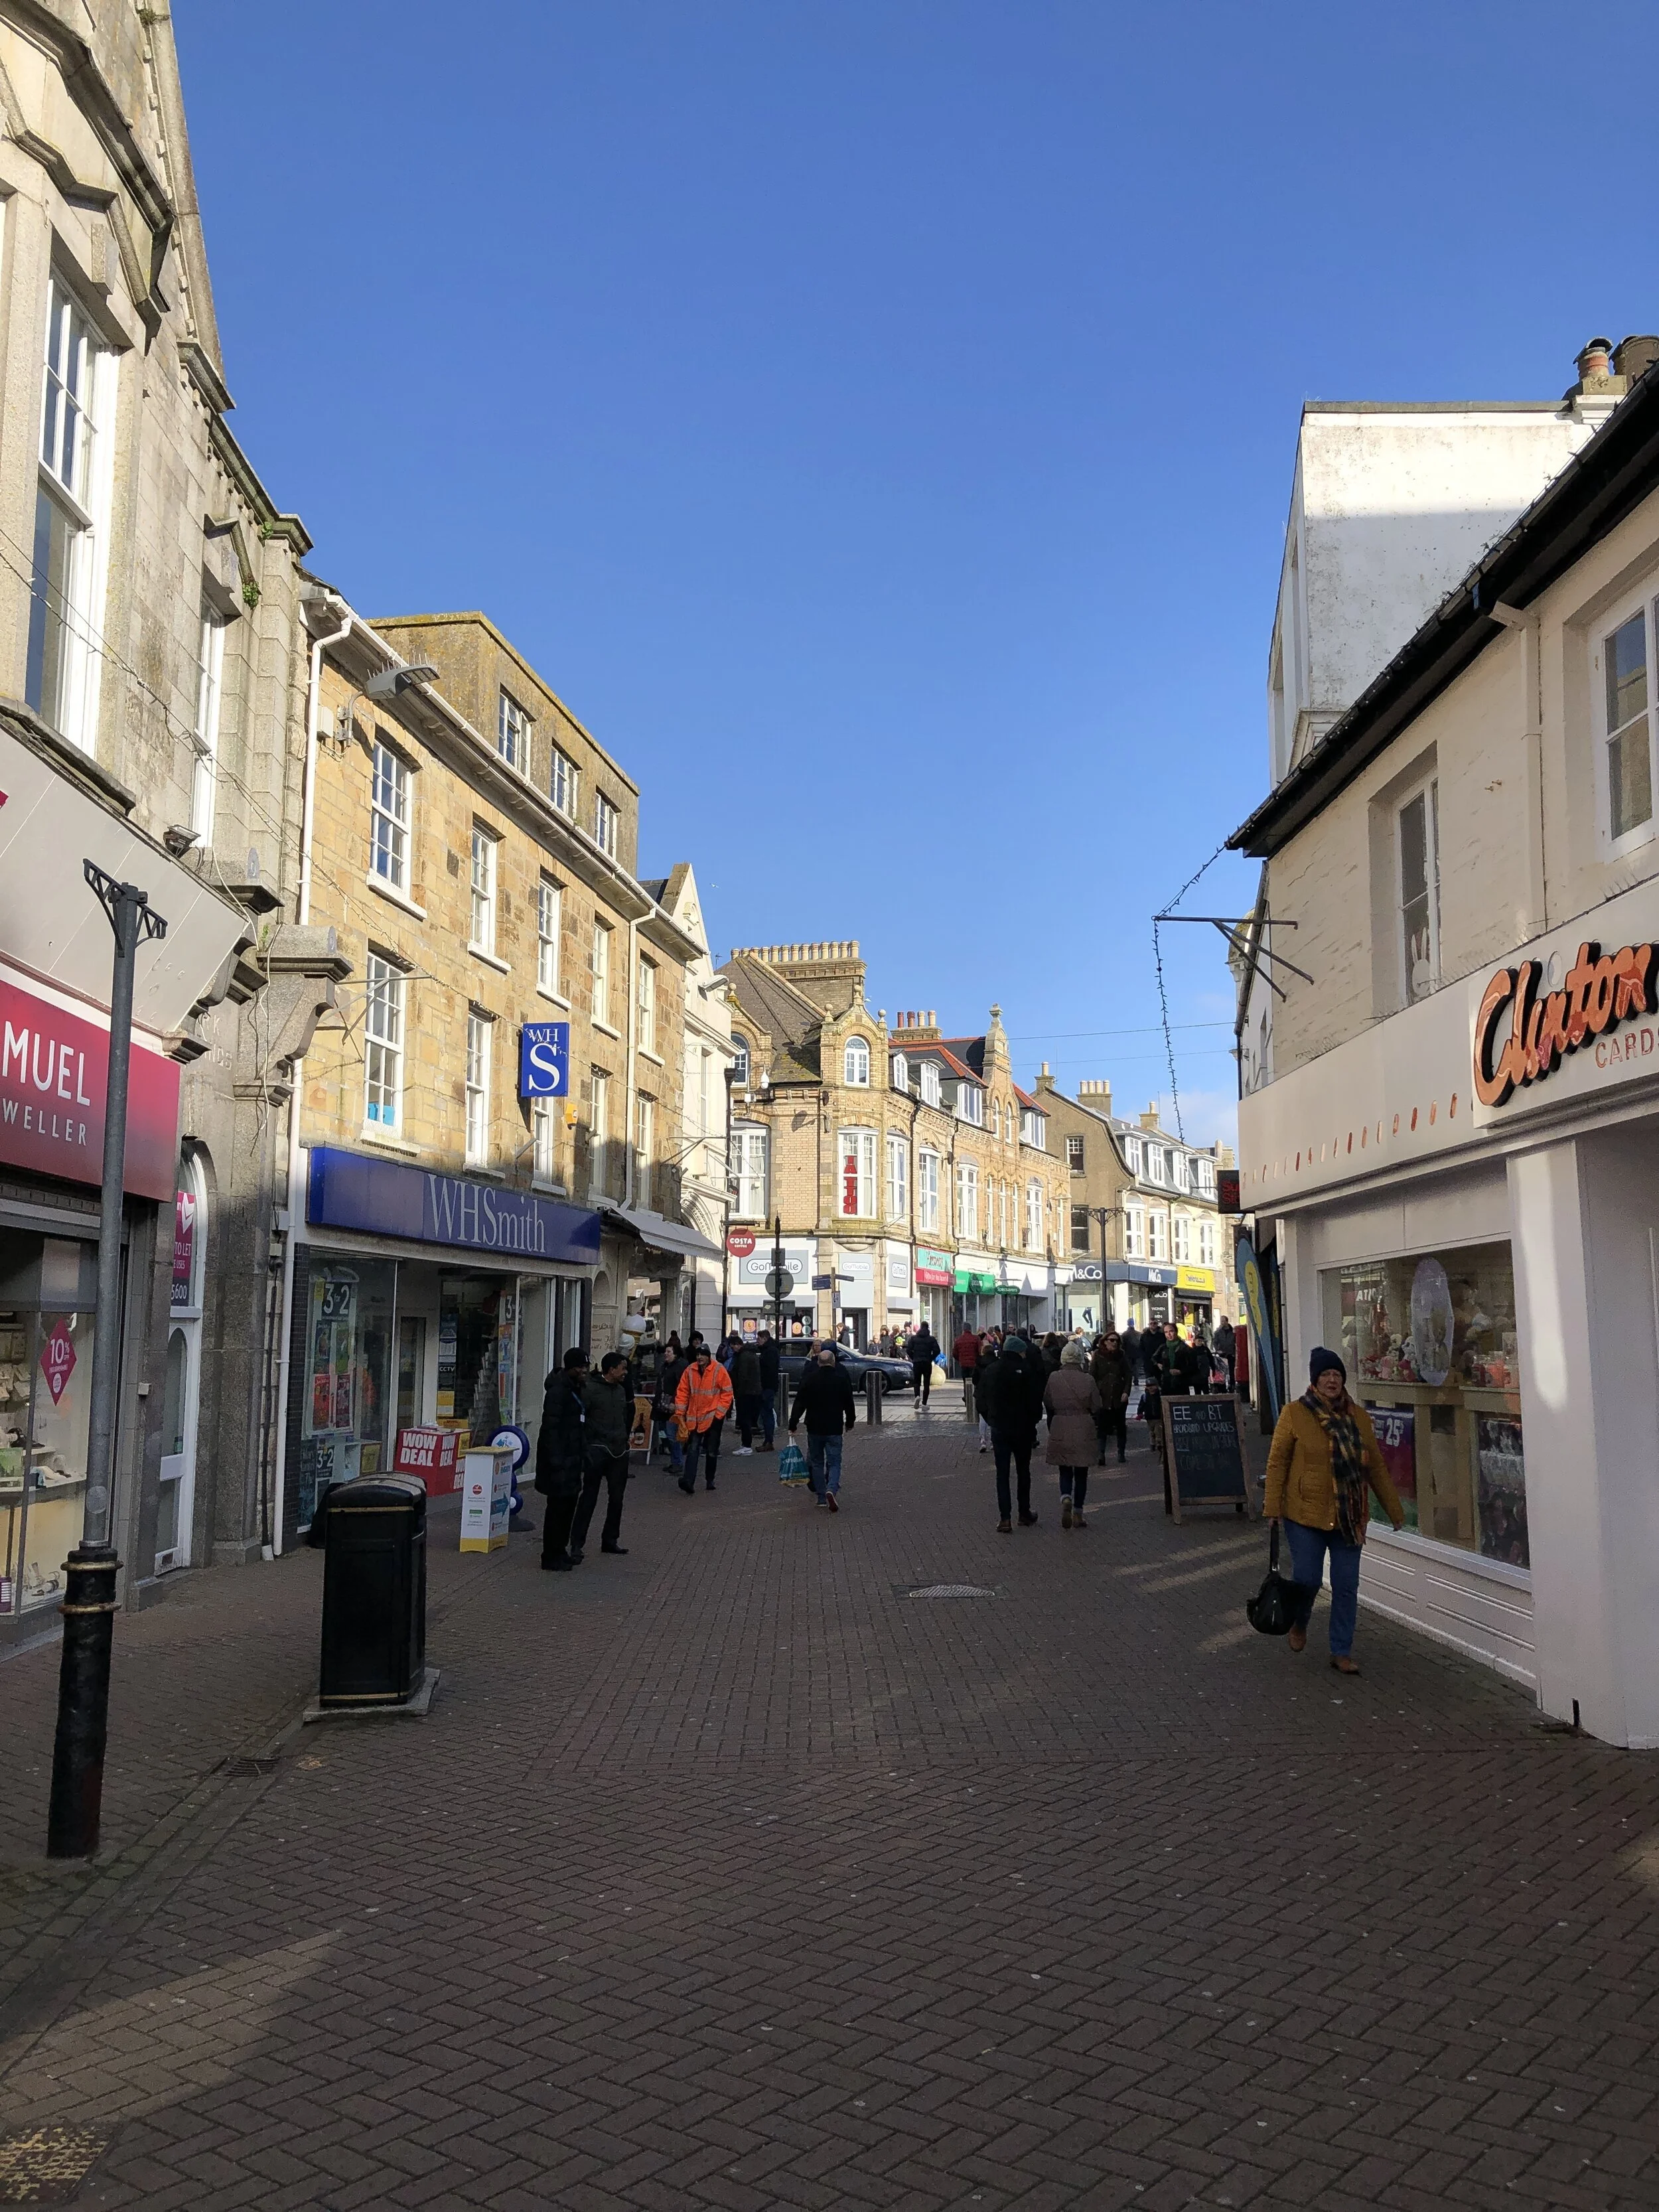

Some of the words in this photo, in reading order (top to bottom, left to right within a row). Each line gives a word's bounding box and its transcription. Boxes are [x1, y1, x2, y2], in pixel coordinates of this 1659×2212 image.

[528, 1028, 559, 1043] WH
[1594, 1028, 1659, 1069] CARD
[528, 1043, 559, 1091] S
[2, 1098, 86, 1146] WELLER
[427, 1173, 546, 1253] WHSmith
[175, 1241, 182, 1256] TO
[182, 1242, 192, 1257] LET
[751, 1261, 799, 1271] GoMile
[323, 1283, 334, 1314] 3
[339, 1284, 350, 1315] 2
[1173, 1406, 1192, 1420] EE
[1208, 1404, 1222, 1420] BT
[403, 1432, 437, 1449] WOW
[400, 1447, 433, 1467] DEAL
[439, 1449, 453, 1467] DEAL
